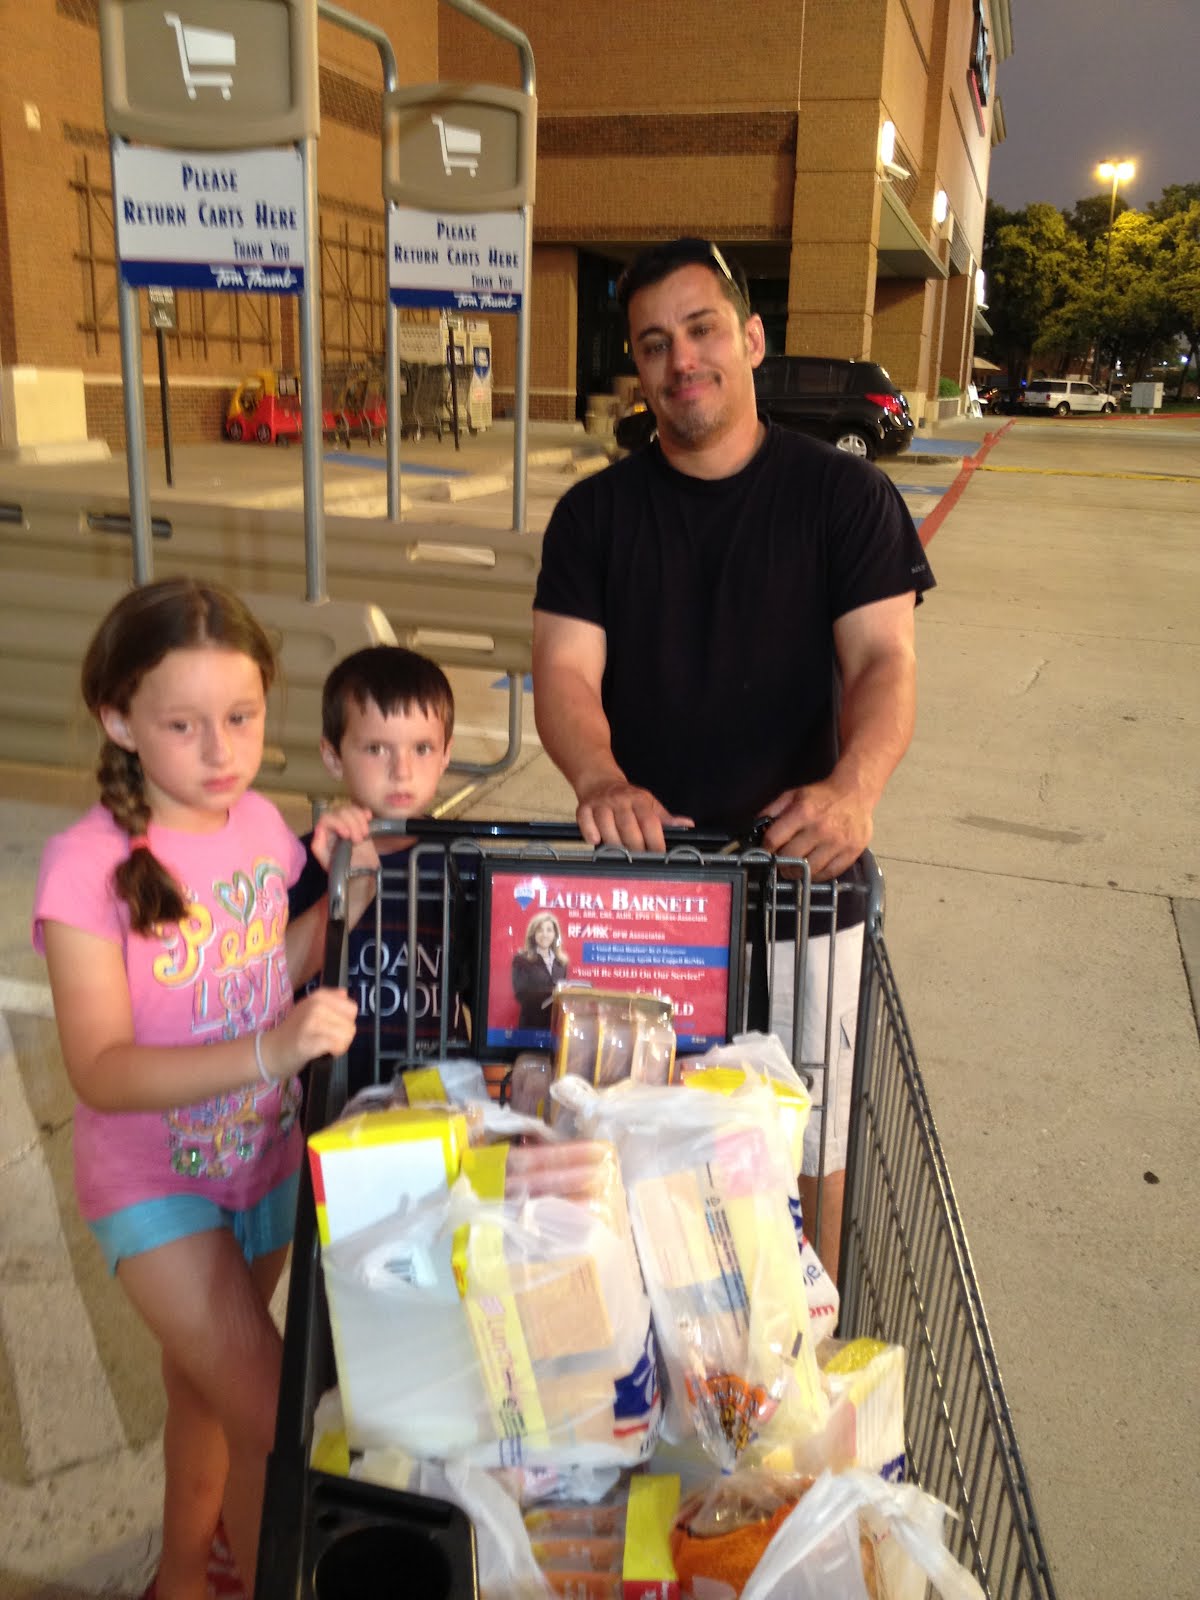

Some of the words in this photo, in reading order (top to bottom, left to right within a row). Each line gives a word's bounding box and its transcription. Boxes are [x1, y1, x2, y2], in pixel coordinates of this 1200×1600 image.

[181, 162, 239, 192] PLEASE
[123, 197, 188, 226] RETURN
[198, 200, 245, 229] CARTS
[255, 201, 298, 231] HERE
[436, 219, 478, 242] PLEASE
[233, 238, 264, 261] THANK
[270, 240, 291, 262] YOU
[394, 244, 440, 265] RETURN
[447, 247, 481, 268] CARTS
[488, 247, 520, 269] HERE
[210, 263, 246, 288] Tom
[243, 263, 298, 289] Thumb
[454, 292, 480, 308] Tom
[478, 293, 518, 309] Thumb
[538, 887, 605, 910] LAURA
[612, 888, 709, 914] BARNETT
